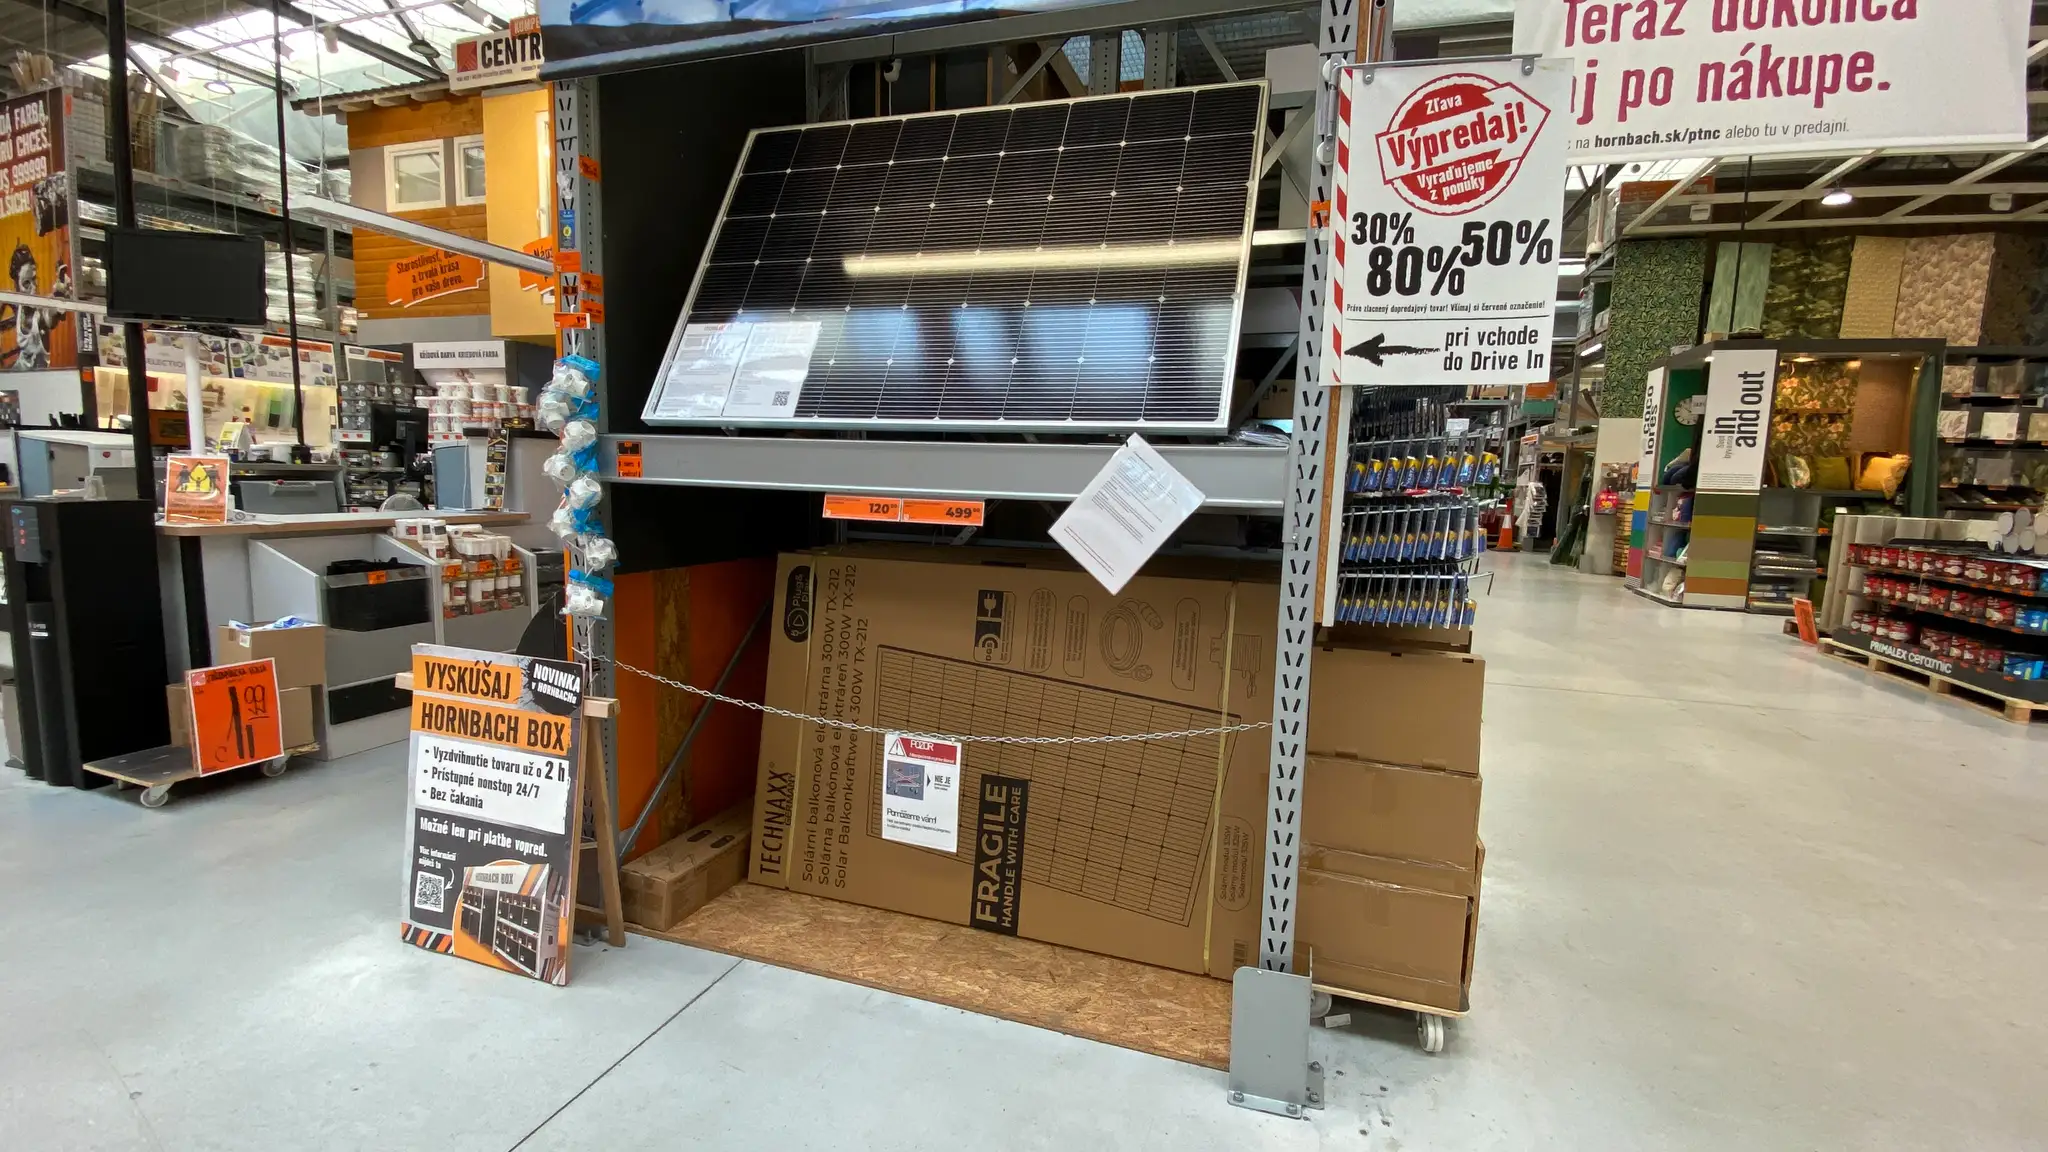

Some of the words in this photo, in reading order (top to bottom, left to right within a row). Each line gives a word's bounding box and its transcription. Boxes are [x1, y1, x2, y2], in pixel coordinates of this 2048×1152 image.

[481, 33, 541, 69] CENTR
[1618, 65, 1673, 122] po
[1696, 42, 1892, 109] nákupe.
[1424, 94, 1463, 116] Zľava
[1386, 101, 1528, 171] Výpredaj!
[1575, 138, 1590, 149] na
[1594, 127, 1721, 148] hornbach.sk/ptnc
[1725, 126, 1760, 140] alebo
[1764, 123, 1777, 137] tu
[1782, 125, 1789, 135] v
[1417, 157, 1494, 189] Vyraďujeme
[1430, 189, 1438, 201] z
[1442, 174, 1486, 201] ponuky
[1351, 211, 1415, 246] 30%
[1460, 218, 1554, 267] 50%
[440, 260, 459, 275] krása
[1366, 245, 1466, 297] 80%
[411, 287, 423, 300] pre
[1363, 304, 1389, 314] zlacnený
[1390, 303, 1427, 314] dopredajový
[1429, 303, 1449, 313] tovar!
[1450, 302, 1472, 314] Všímaj
[1473, 303, 1480, 312] si
[1481, 301, 1508, 311] červené
[1445, 327, 1470, 351] pri
[1477, 325, 1539, 347] vchode
[1443, 352, 1463, 371] do
[1471, 350, 1518, 371] Drive
[1526, 350, 1544, 370] In
[1738, 371, 1766, 405] out
[1707, 417, 1737, 434] in
[1732, 410, 1761, 448] and
[869, 503, 889, 514] 120
[946, 507, 972, 519] 499
[826, 568, 840, 613] TX-212
[843, 564, 857, 610] TX-212
[822, 617, 836, 662] 300W
[838, 613, 852, 659] 300W
[854, 618, 869, 664] TX-212
[1870, 640, 1907, 662] PRIMALEX
[1908, 652, 1953, 674] ceramic
[425, 660, 511, 700] VYSKÚŠAJ
[533, 663, 581, 693] NOVINKA
[850, 668, 864, 714] 300W
[421, 702, 519, 744] HORNBACH
[527, 718, 565, 751] BOX
[431, 766, 474, 787] Prístupné
[478, 777, 513, 794] nonstop
[516, 782, 540, 799] 24/7
[433, 746, 488, 768] Vyzdvihnutie
[492, 757, 520, 774] tovaru
[523, 761, 534, 776] už
[536, 767, 542, 778] o
[545, 761, 553, 780] 2
[558, 762, 565, 782] h
[430, 787, 447, 801] Bez
[450, 789, 483, 809] čakania
[807, 748, 824, 825] balkonová
[1010, 786, 1022, 825] CARE
[420, 817, 449, 835] Možné
[451, 822, 465, 838] len
[468, 828, 481, 843] pri
[483, 831, 512, 849] platbe
[515, 839, 548, 857] vopred.
[759, 770, 790, 874] TECHNAXX
[819, 828, 833, 885] Solárna
[976, 783, 1007, 923] FRAGILE
[1006, 827, 1019, 865] WITH
[501, 873, 514, 885] BOX
[835, 850, 848, 888] Solar
[1001, 868, 1016, 928] HANDLE
